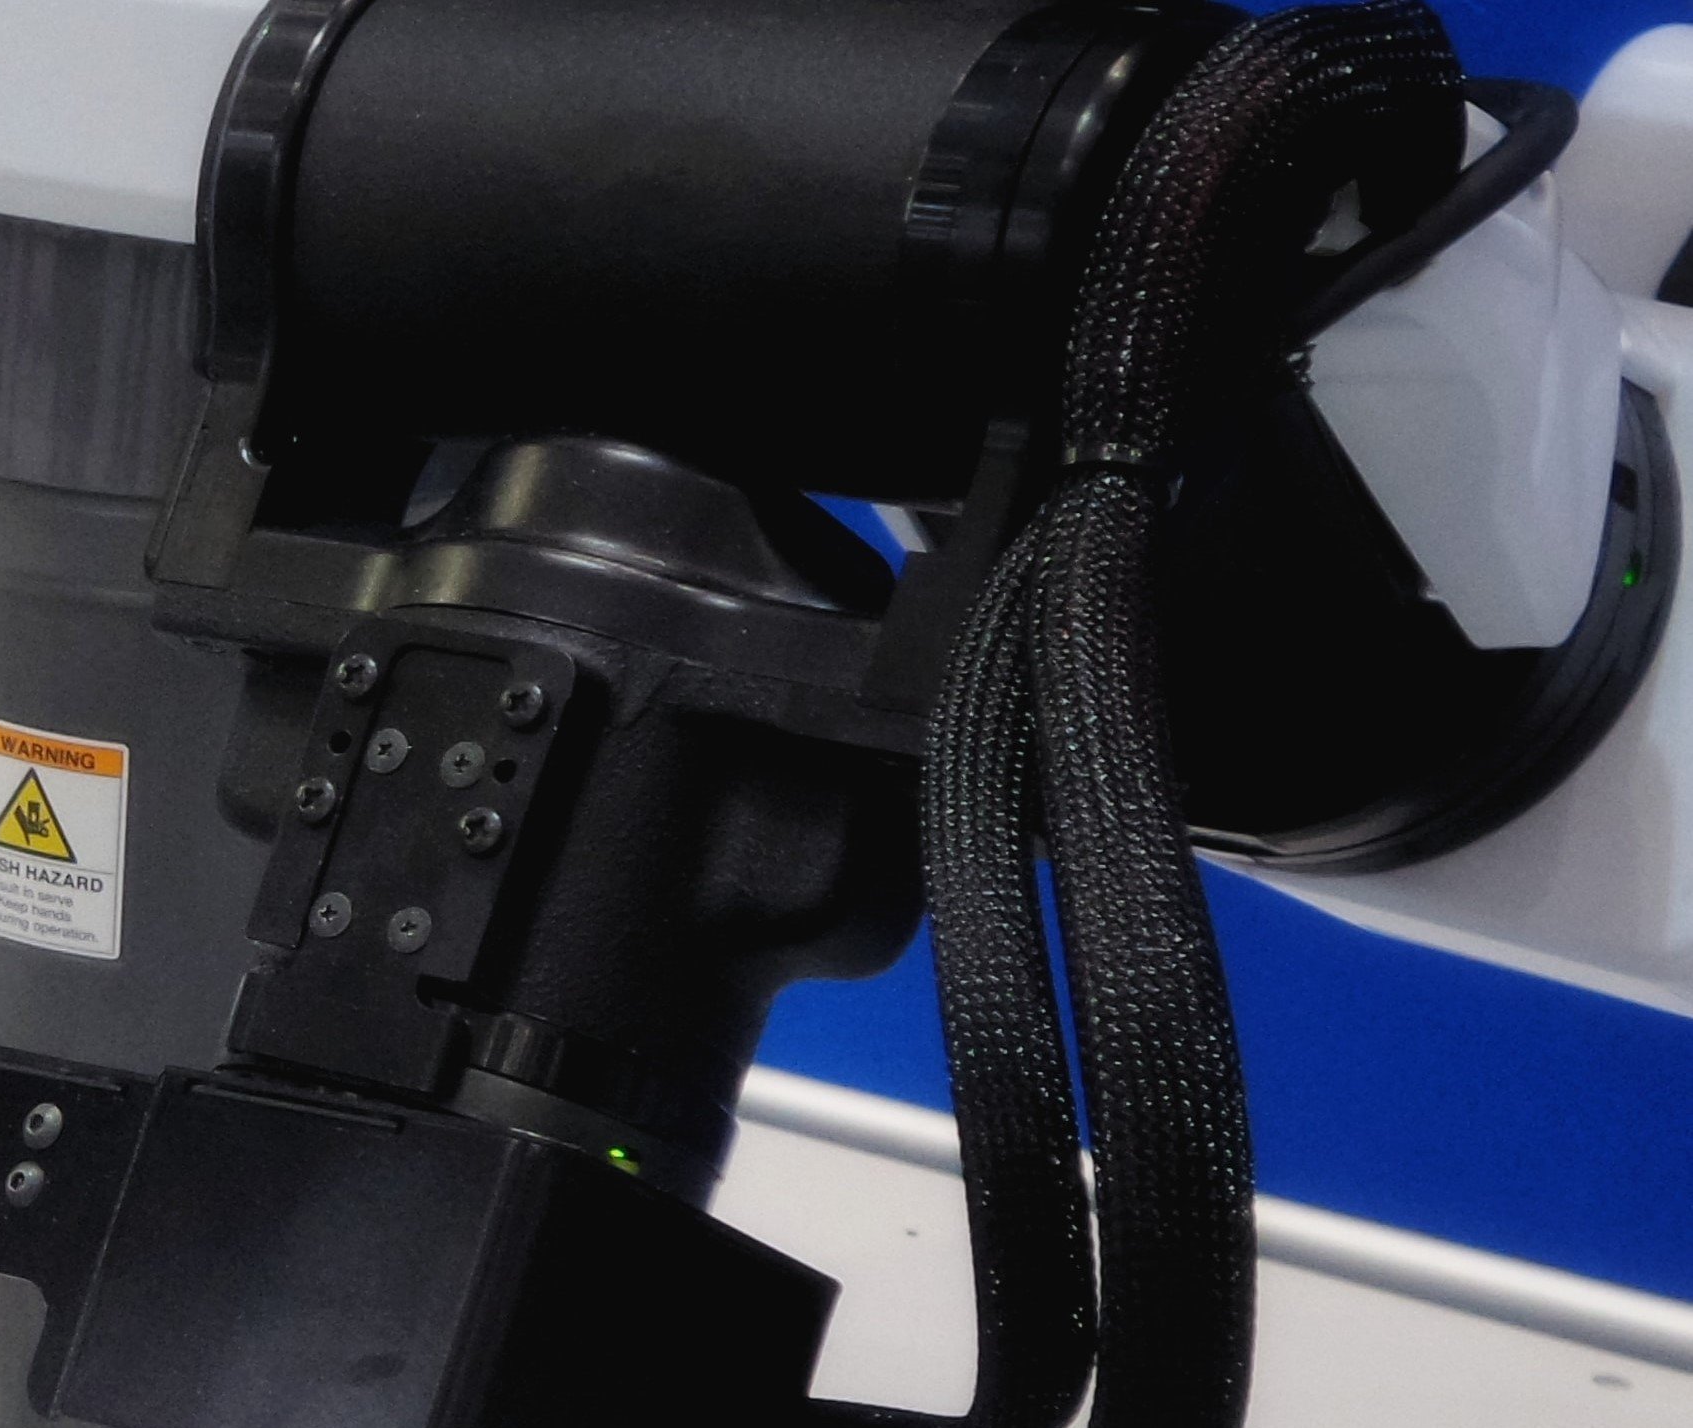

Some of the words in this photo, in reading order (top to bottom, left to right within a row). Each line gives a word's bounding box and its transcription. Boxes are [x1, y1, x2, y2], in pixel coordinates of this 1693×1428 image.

[0, 735, 96, 769] WARNING
[26, 865, 103, 893] HAZARD
[32, 905, 71, 922] hands
